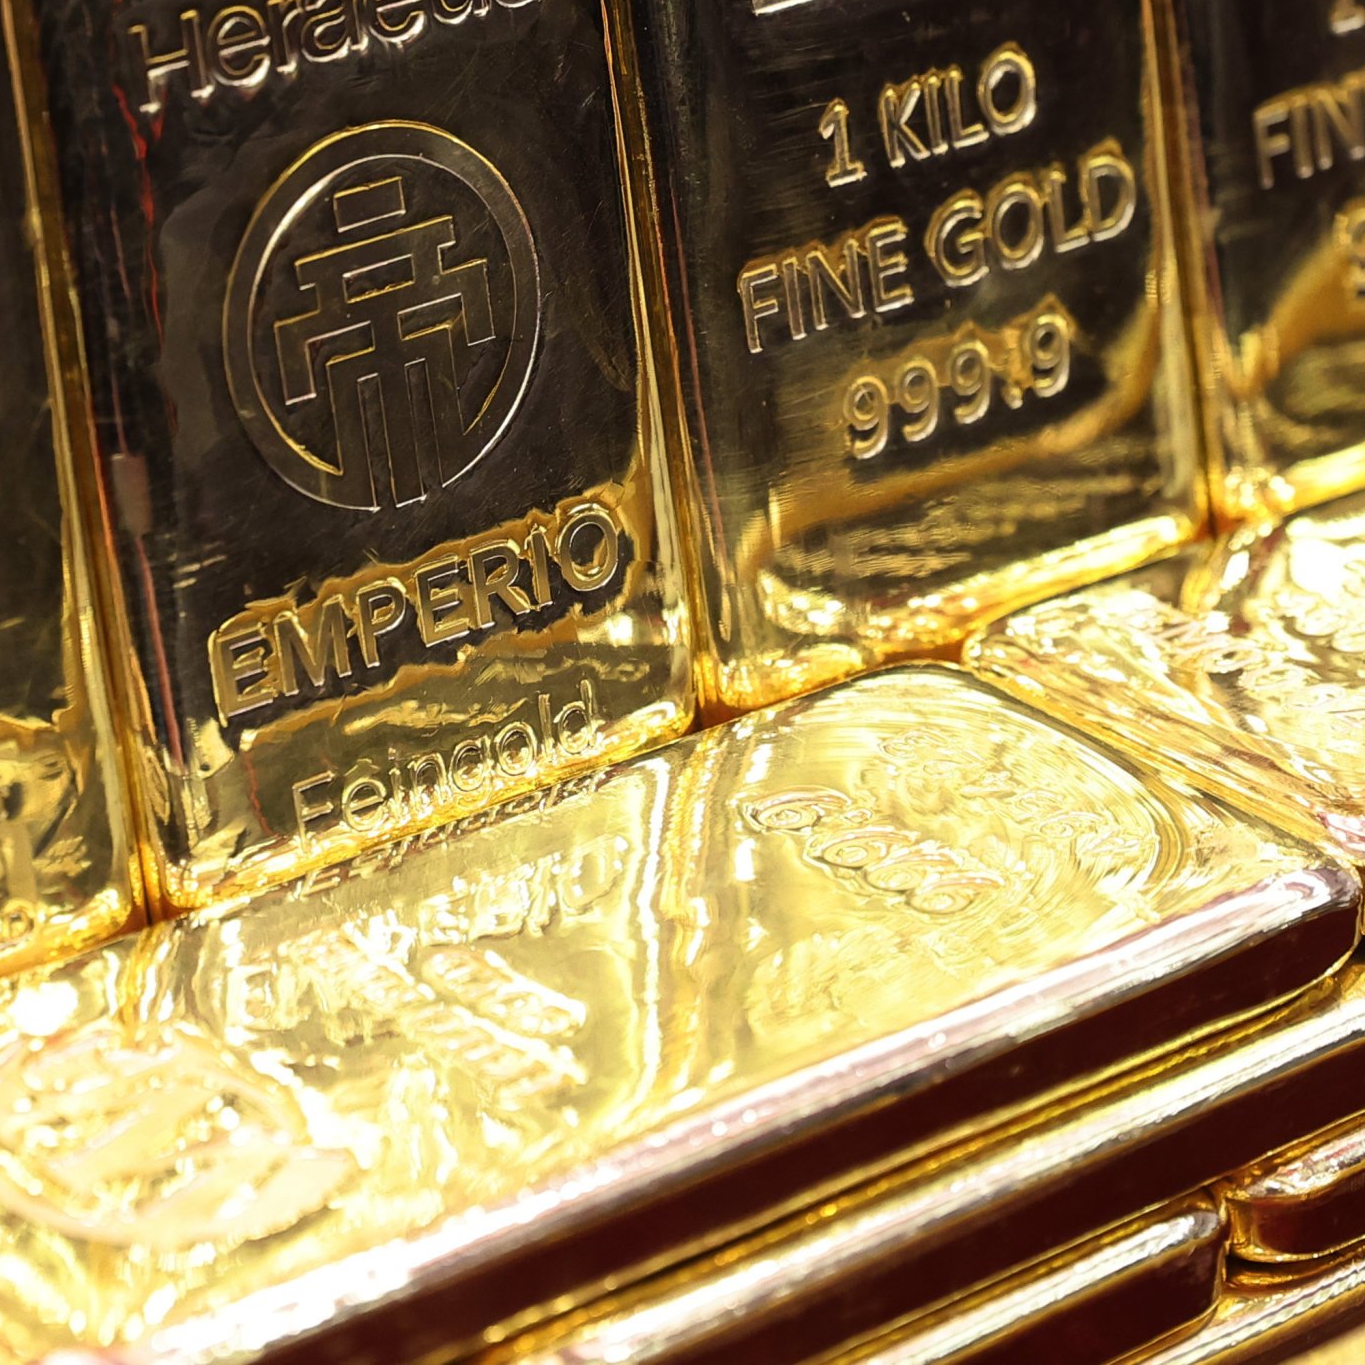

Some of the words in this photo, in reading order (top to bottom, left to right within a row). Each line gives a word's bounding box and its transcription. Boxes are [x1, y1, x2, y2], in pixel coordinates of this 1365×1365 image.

[817, 98, 867, 188] 1
[879, 40, 1039, 169] KILO
[738, 216, 914, 354] FINE
[926, 140, 1137, 288] GOLD
[842, 299, 1075, 462] 999.9
[211, 501, 624, 721] EMPERIO
[291, 697, 601, 843] Feingold
